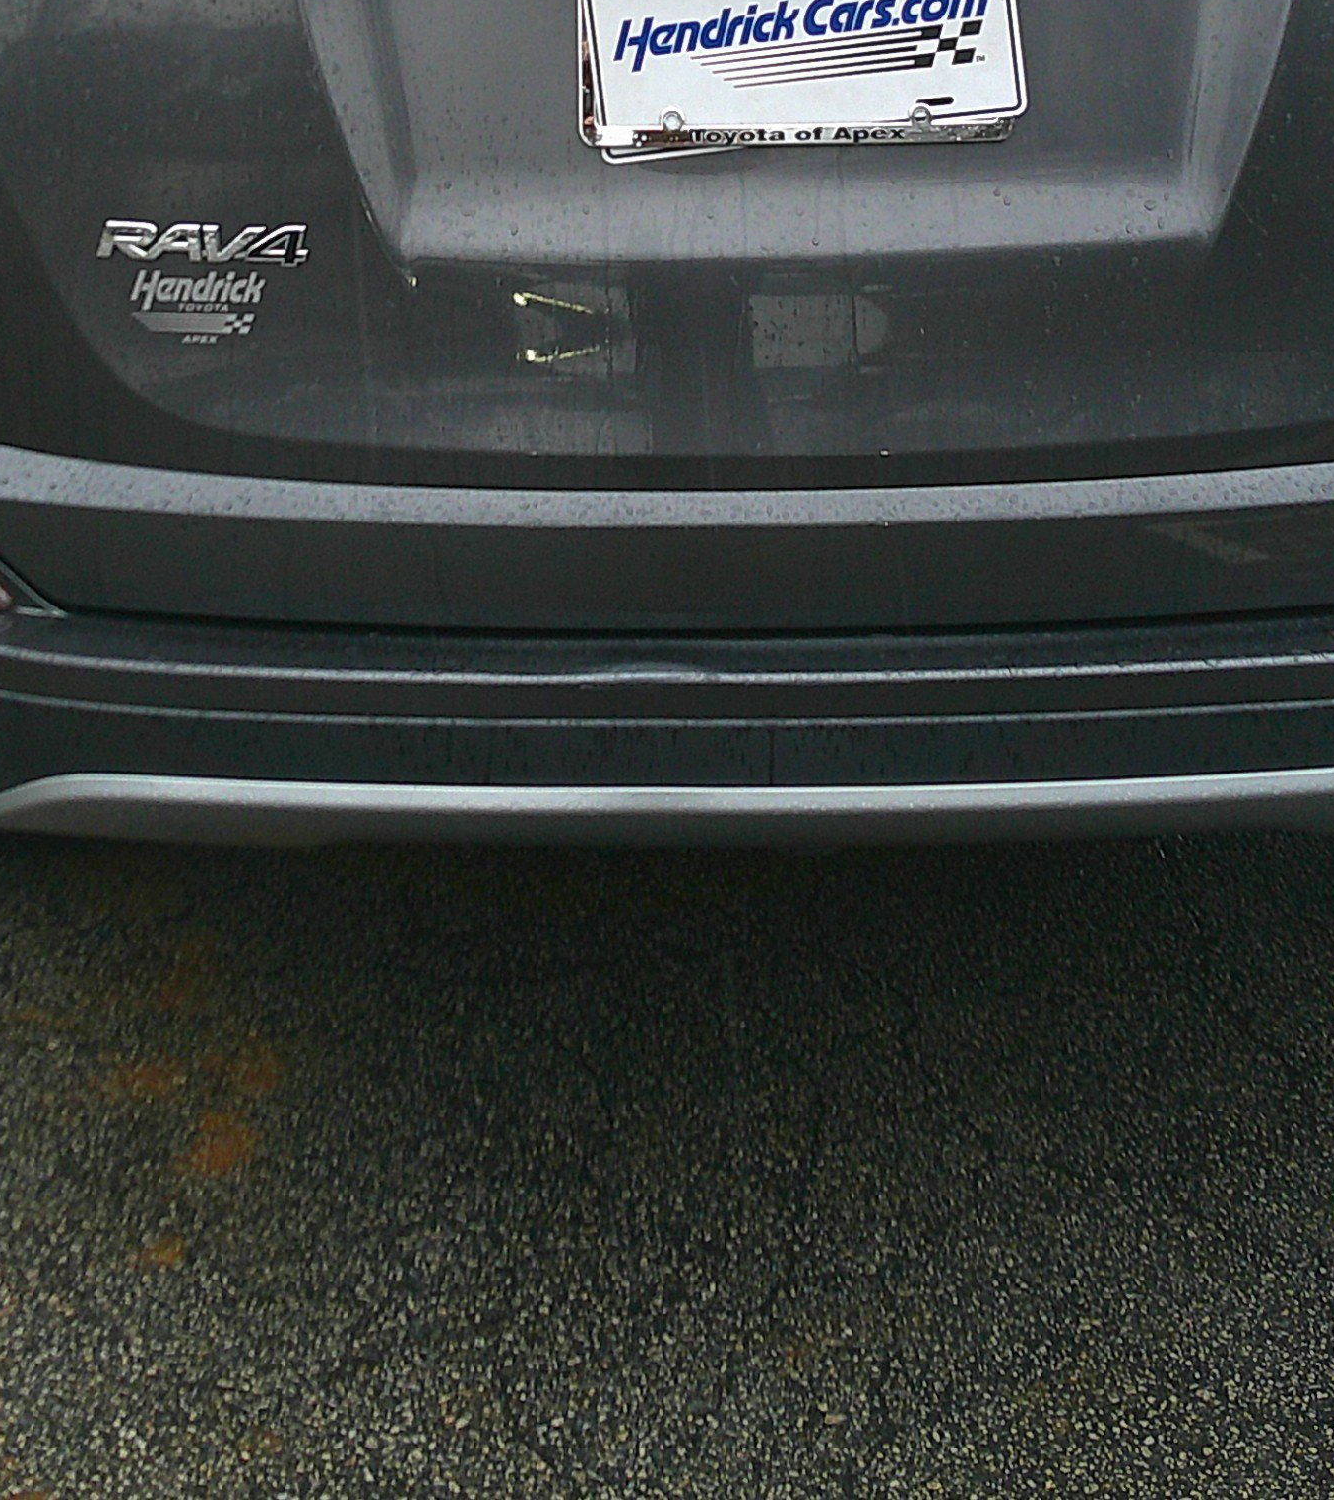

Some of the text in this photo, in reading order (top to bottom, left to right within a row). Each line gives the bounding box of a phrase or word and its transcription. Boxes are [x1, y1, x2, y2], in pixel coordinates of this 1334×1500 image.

[689, 126, 905, 144] Toyota of Apex
[95, 219, 310, 267] RAV4
[130, 269, 266, 311] Hendrick
[177, 303, 229, 312] TOYOTA
[181, 334, 219, 345] APEX
